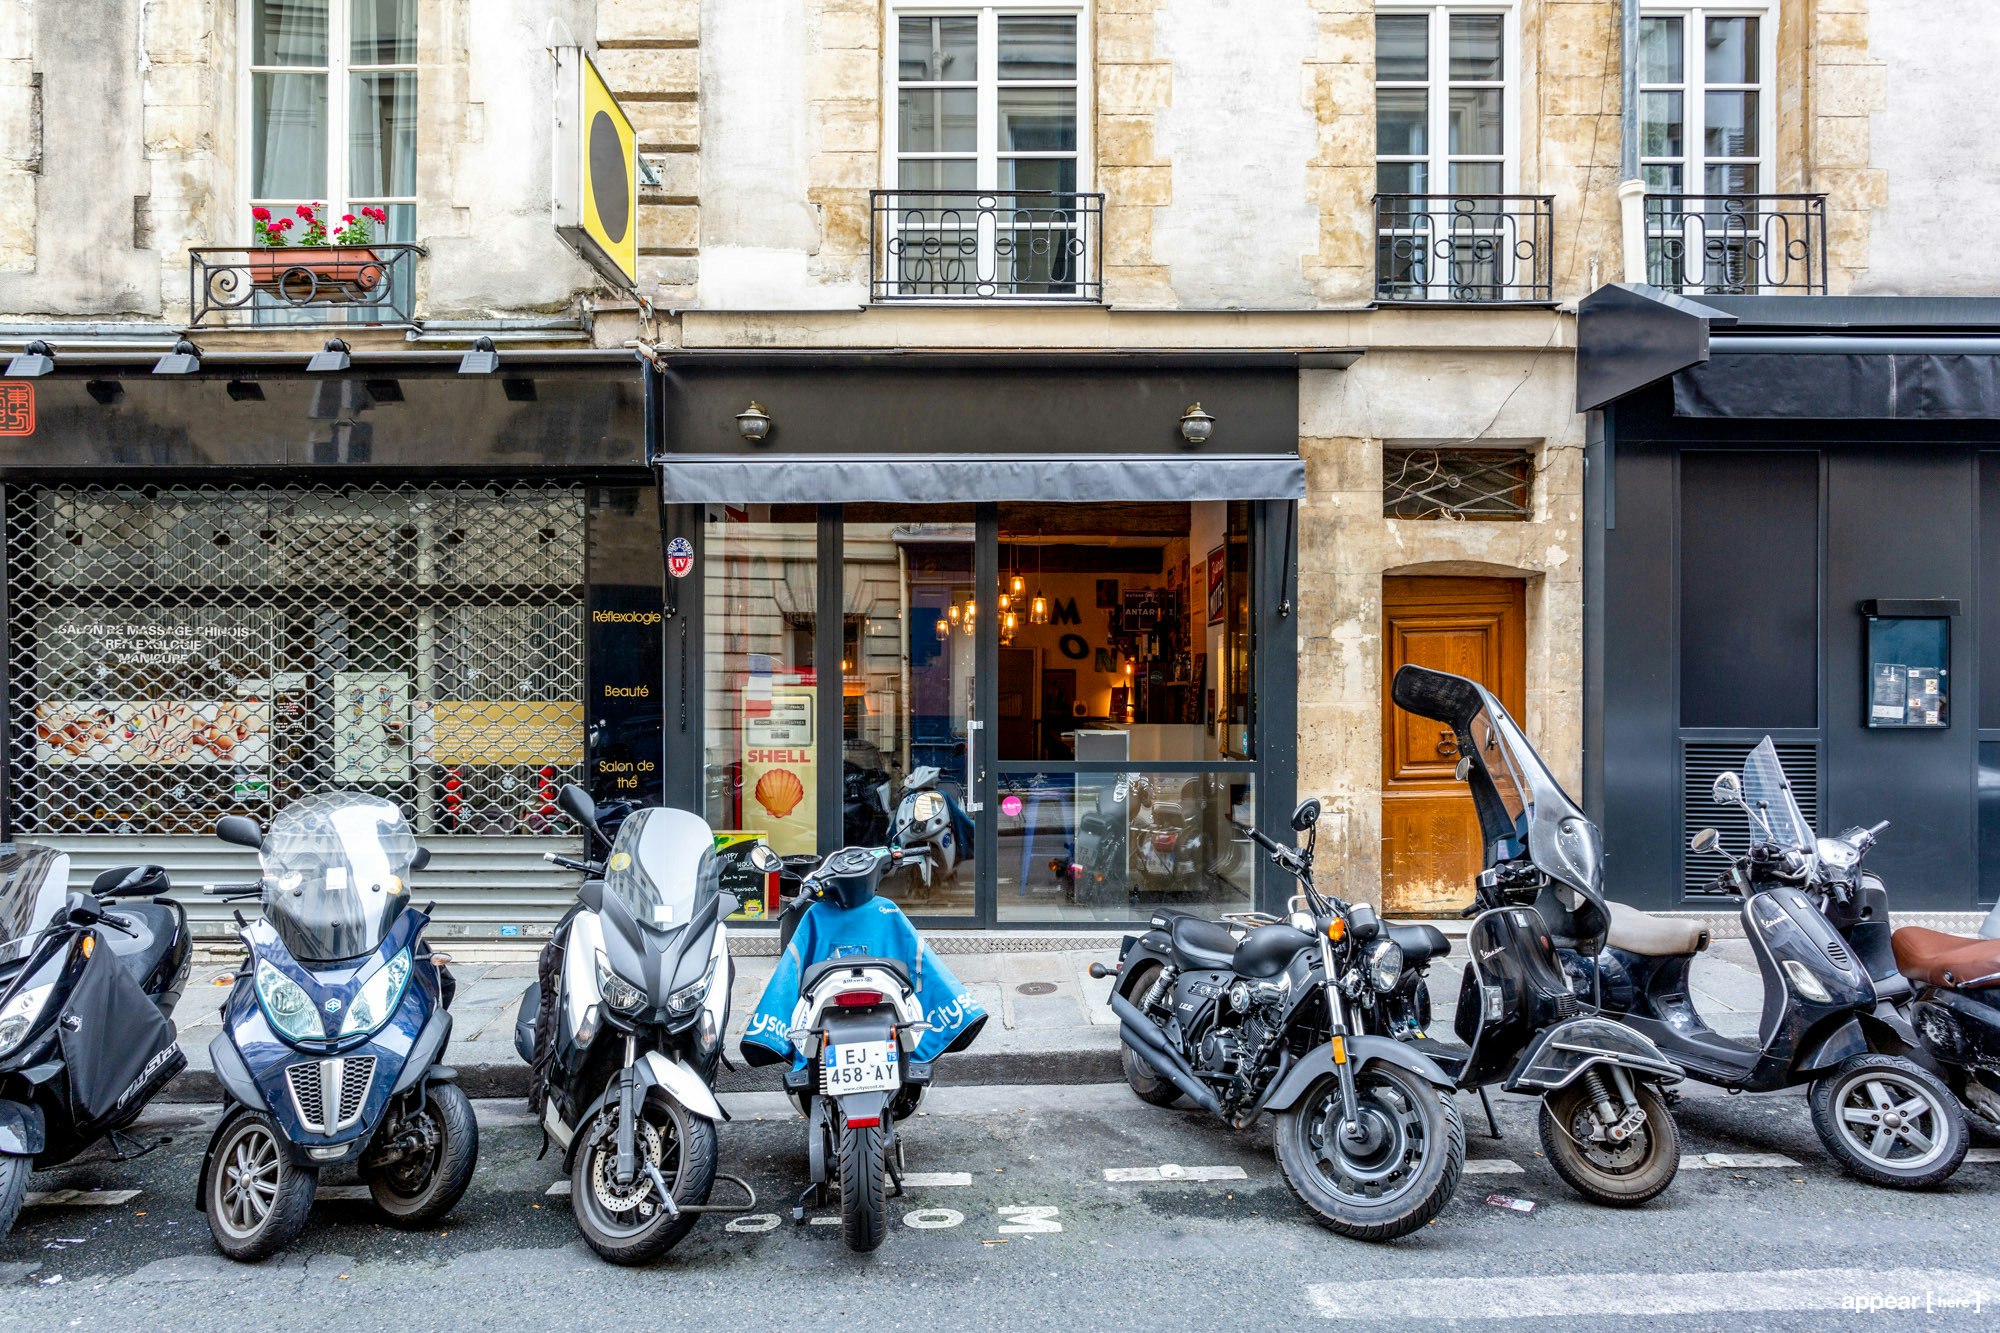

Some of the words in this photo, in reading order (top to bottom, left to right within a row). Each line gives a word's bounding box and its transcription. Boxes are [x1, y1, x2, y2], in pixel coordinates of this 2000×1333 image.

[675, 559, 686, 567] IV
[592, 610, 661, 625] Réflexologie
[127, 625, 193, 636] MASSAGE
[604, 685, 649, 697] Beauté
[747, 749, 811, 763] SHELL
[599, 760, 633, 772] Salon
[637, 760, 654, 771] de
[887, 1053, 896, 1061] 75
[831, 1064, 893, 1085] 458-AY
